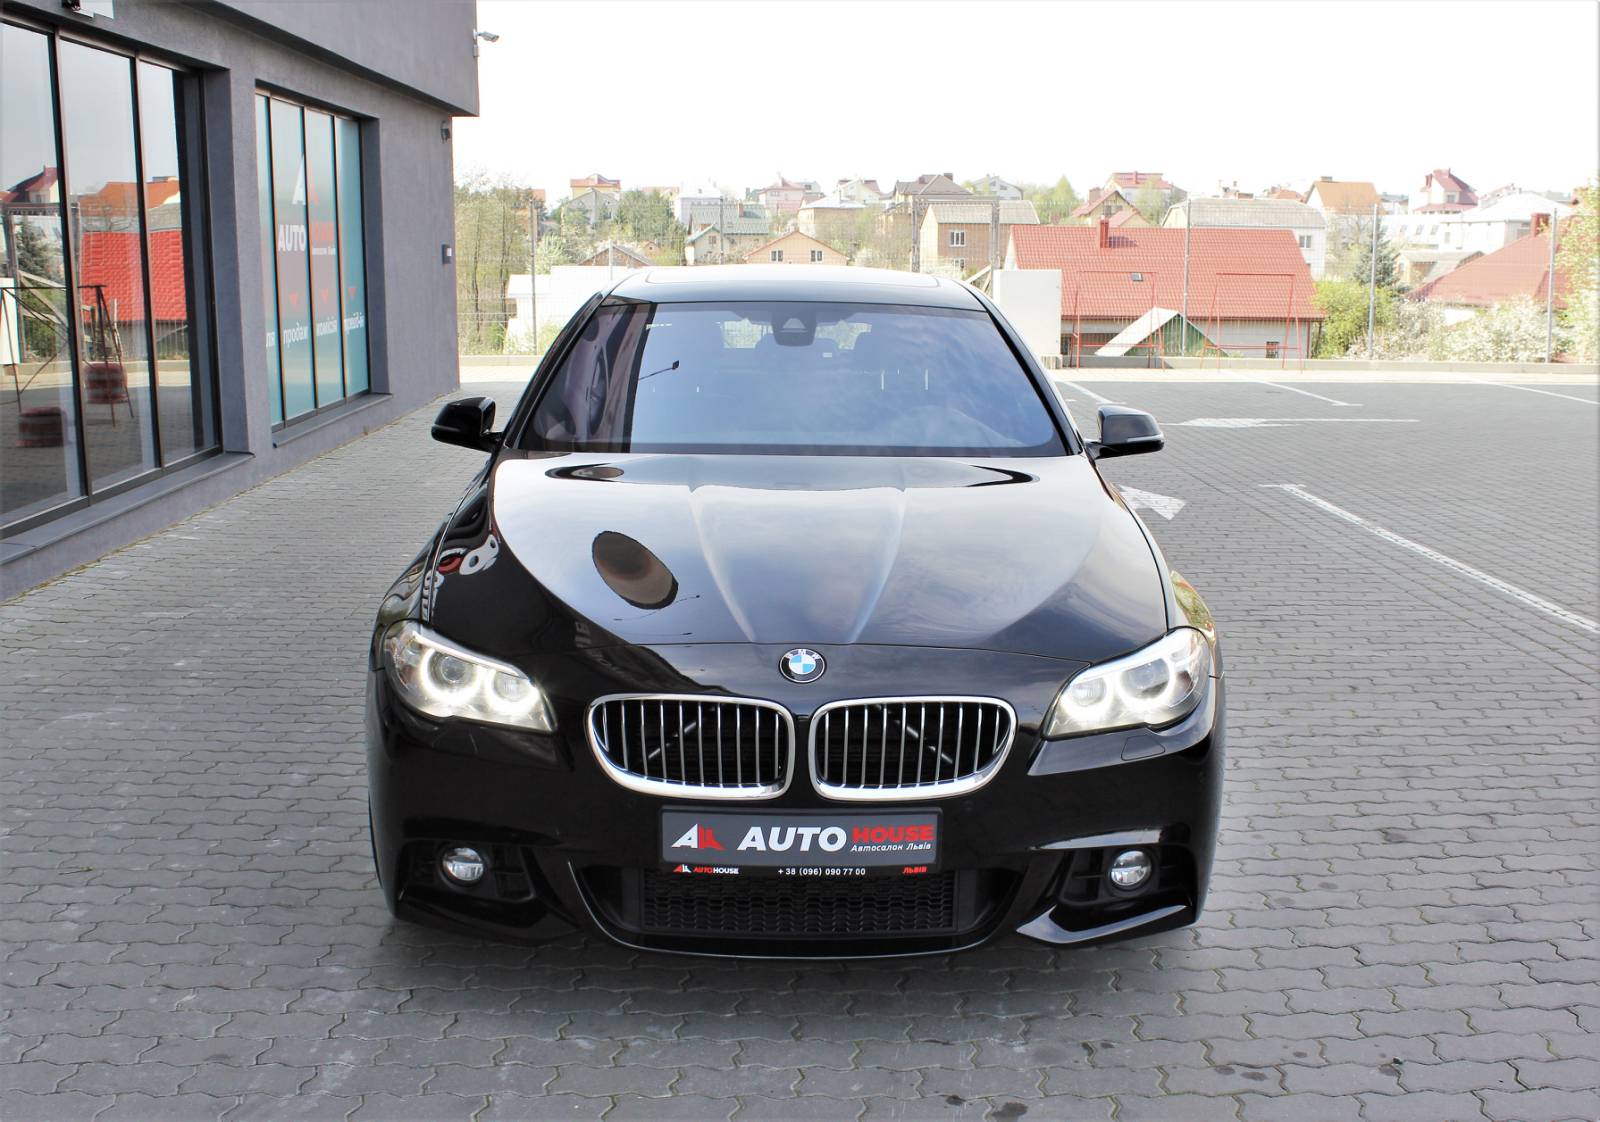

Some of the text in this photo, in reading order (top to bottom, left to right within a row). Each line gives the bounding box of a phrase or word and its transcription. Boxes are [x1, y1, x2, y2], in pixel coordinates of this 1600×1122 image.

[278, 224, 307, 252] AUTO
[736, 823, 935, 852] AUTO HOUSE
[850, 841, 931, 853] Автосалон Львів
[785, 867, 796, 875] 38
[799, 867, 822, 876] (096)
[825, 867, 841, 876] 090
[842, 867, 854, 876] 77
[855, 867, 866, 876] 00
